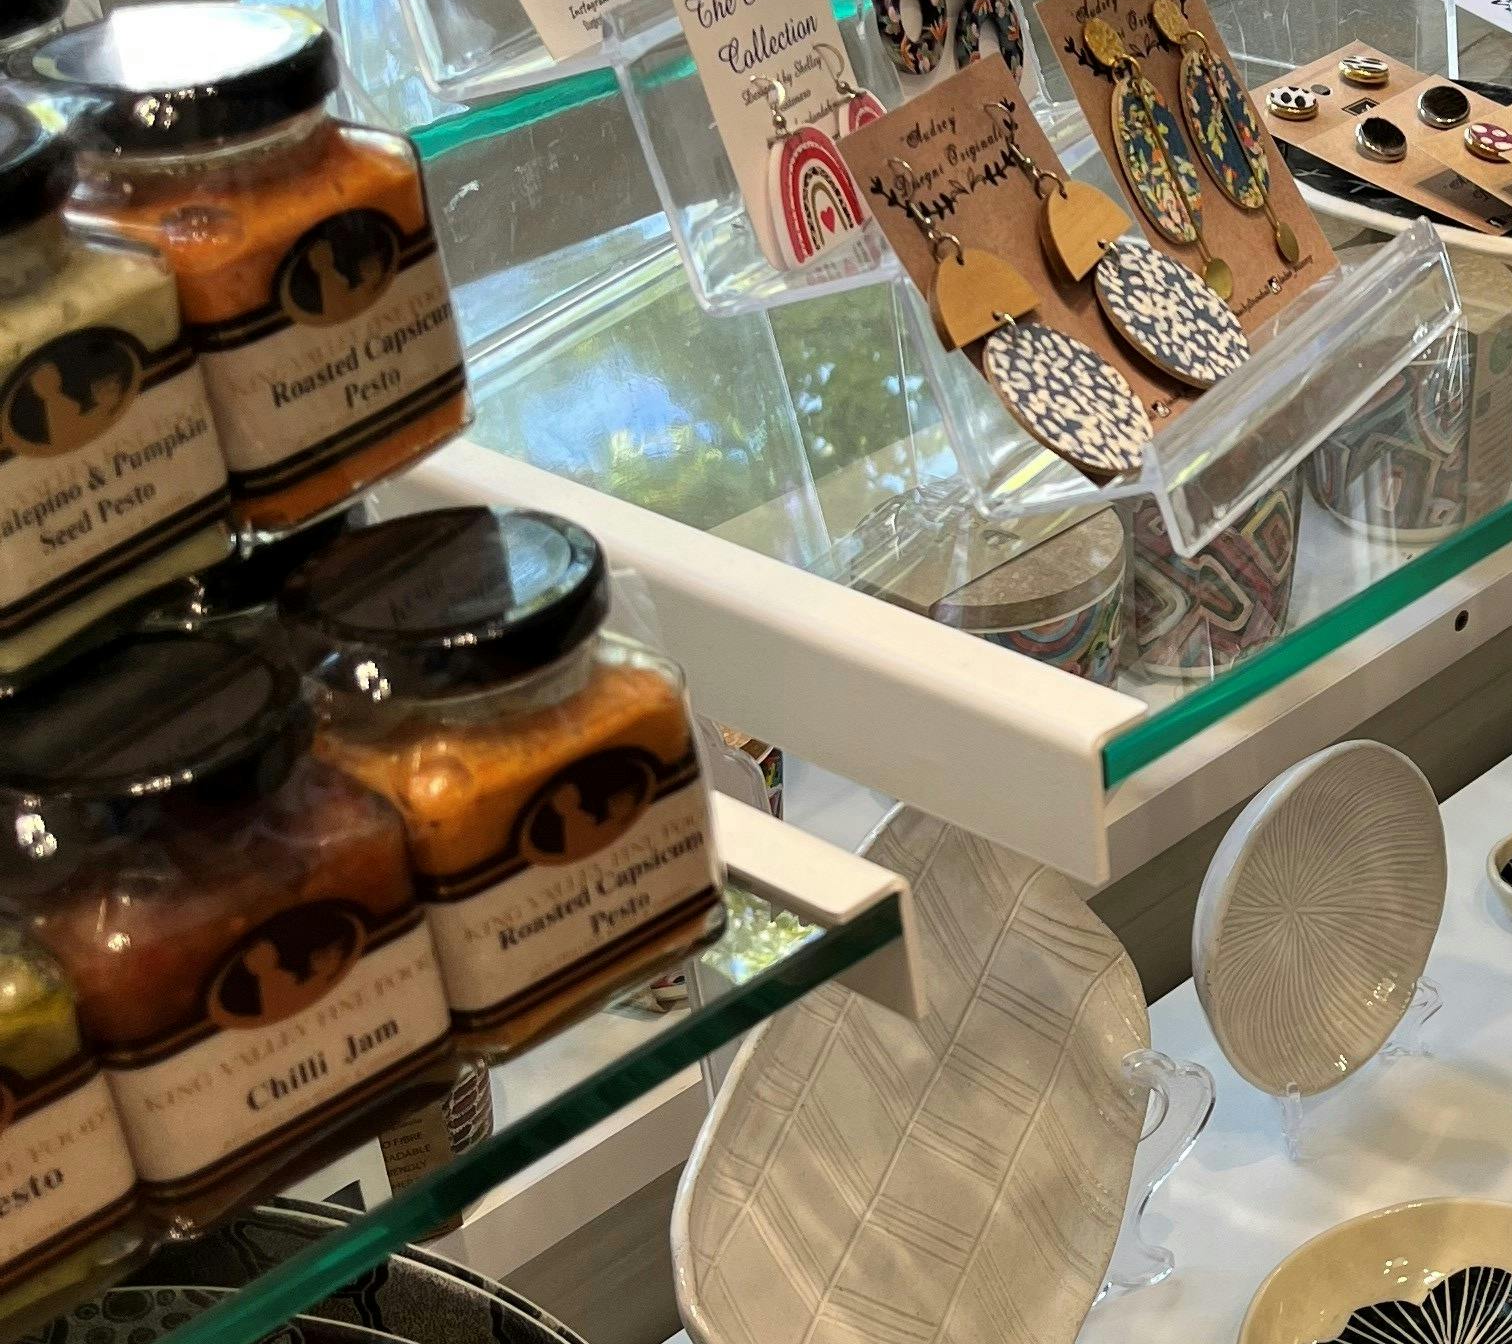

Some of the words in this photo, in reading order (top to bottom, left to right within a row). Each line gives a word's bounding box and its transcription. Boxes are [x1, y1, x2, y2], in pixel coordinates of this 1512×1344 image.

[718, 14, 818, 75] Collection
[270, 344, 359, 409] Roasted
[343, 367, 401, 410] Pesto
[0, 483, 84, 540] alepino
[86, 465, 107, 492] &
[112, 417, 209, 480] Pumpkin
[39, 509, 94, 549] Seed
[97, 482, 157, 525] Pesto
[499, 886, 592, 951] Roasted
[594, 831, 705, 897] Capsicum
[590, 891, 651, 939] Pesto
[245, 1047, 330, 1112] Chilli
[343, 1016, 400, 1066] Jam
